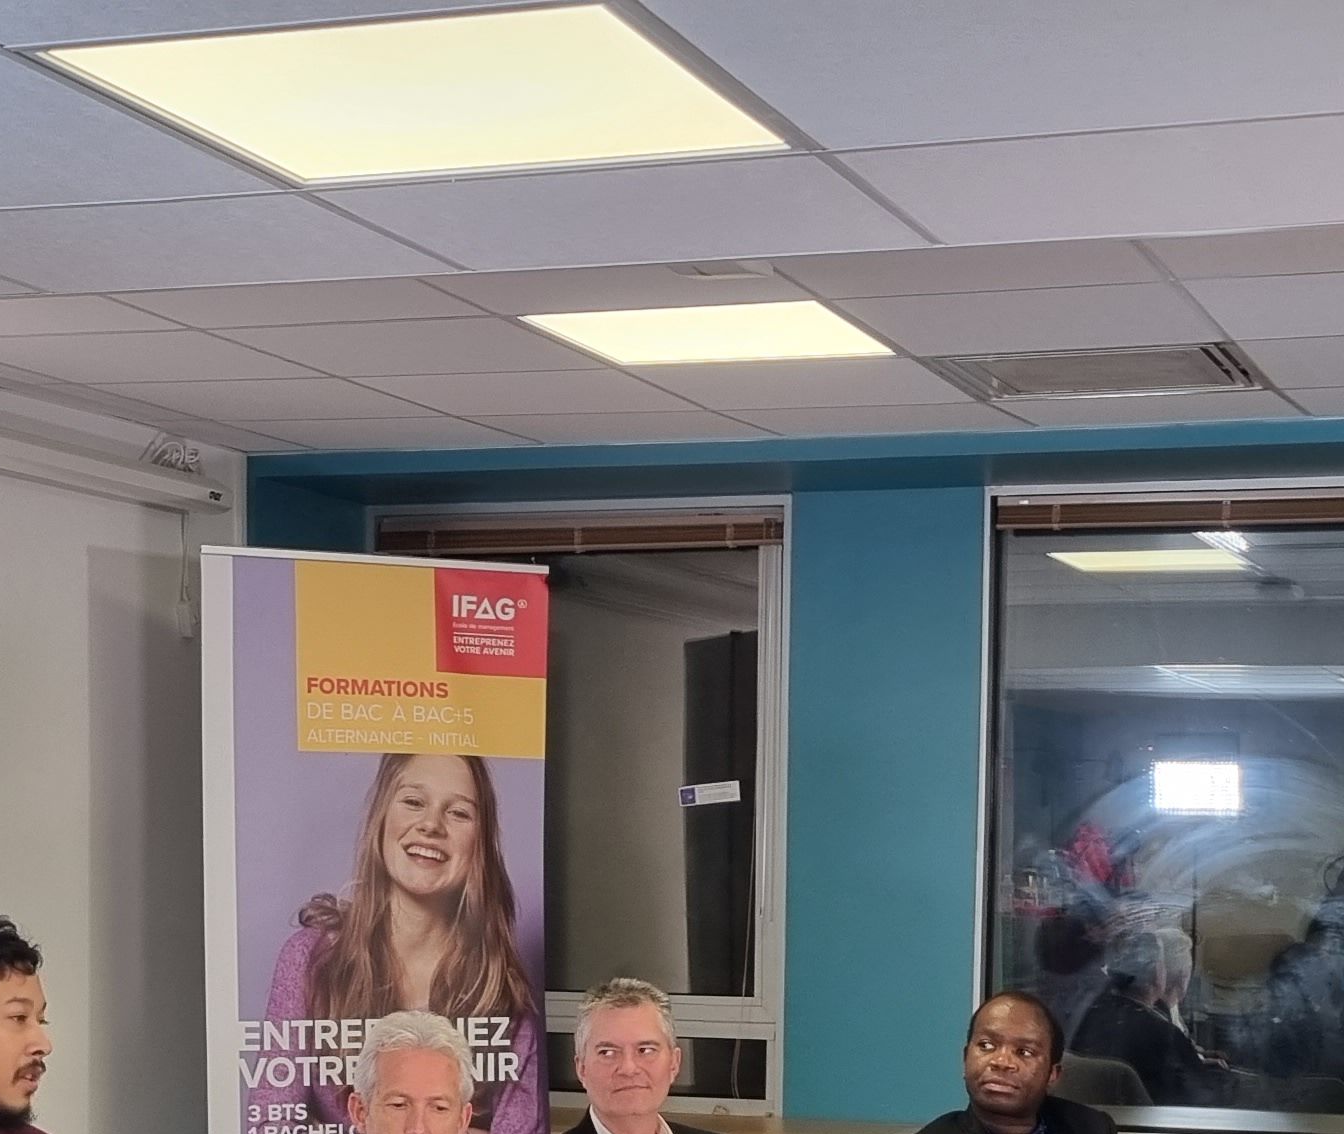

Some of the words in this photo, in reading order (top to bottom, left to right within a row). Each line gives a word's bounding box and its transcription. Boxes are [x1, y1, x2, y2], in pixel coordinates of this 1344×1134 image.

[452, 594, 515, 620] IFAG
[453, 636, 515, 648] ENTREPRENEZ
[453, 645, 481, 655] VOTRE
[483, 647, 515, 657] AVENIR
[307, 677, 449, 698] FORMATIONS
[307, 702, 334, 720] DE
[341, 703, 383, 721] BAC
[392, 700, 406, 722] À
[413, 704, 474, 725] BAC+5
[307, 728, 413, 746] ALTERNANCE
[429, 732, 479, 748] INITIAL
[248, 1104, 261, 1122] 3
[268, 1103, 308, 1122] BTS
